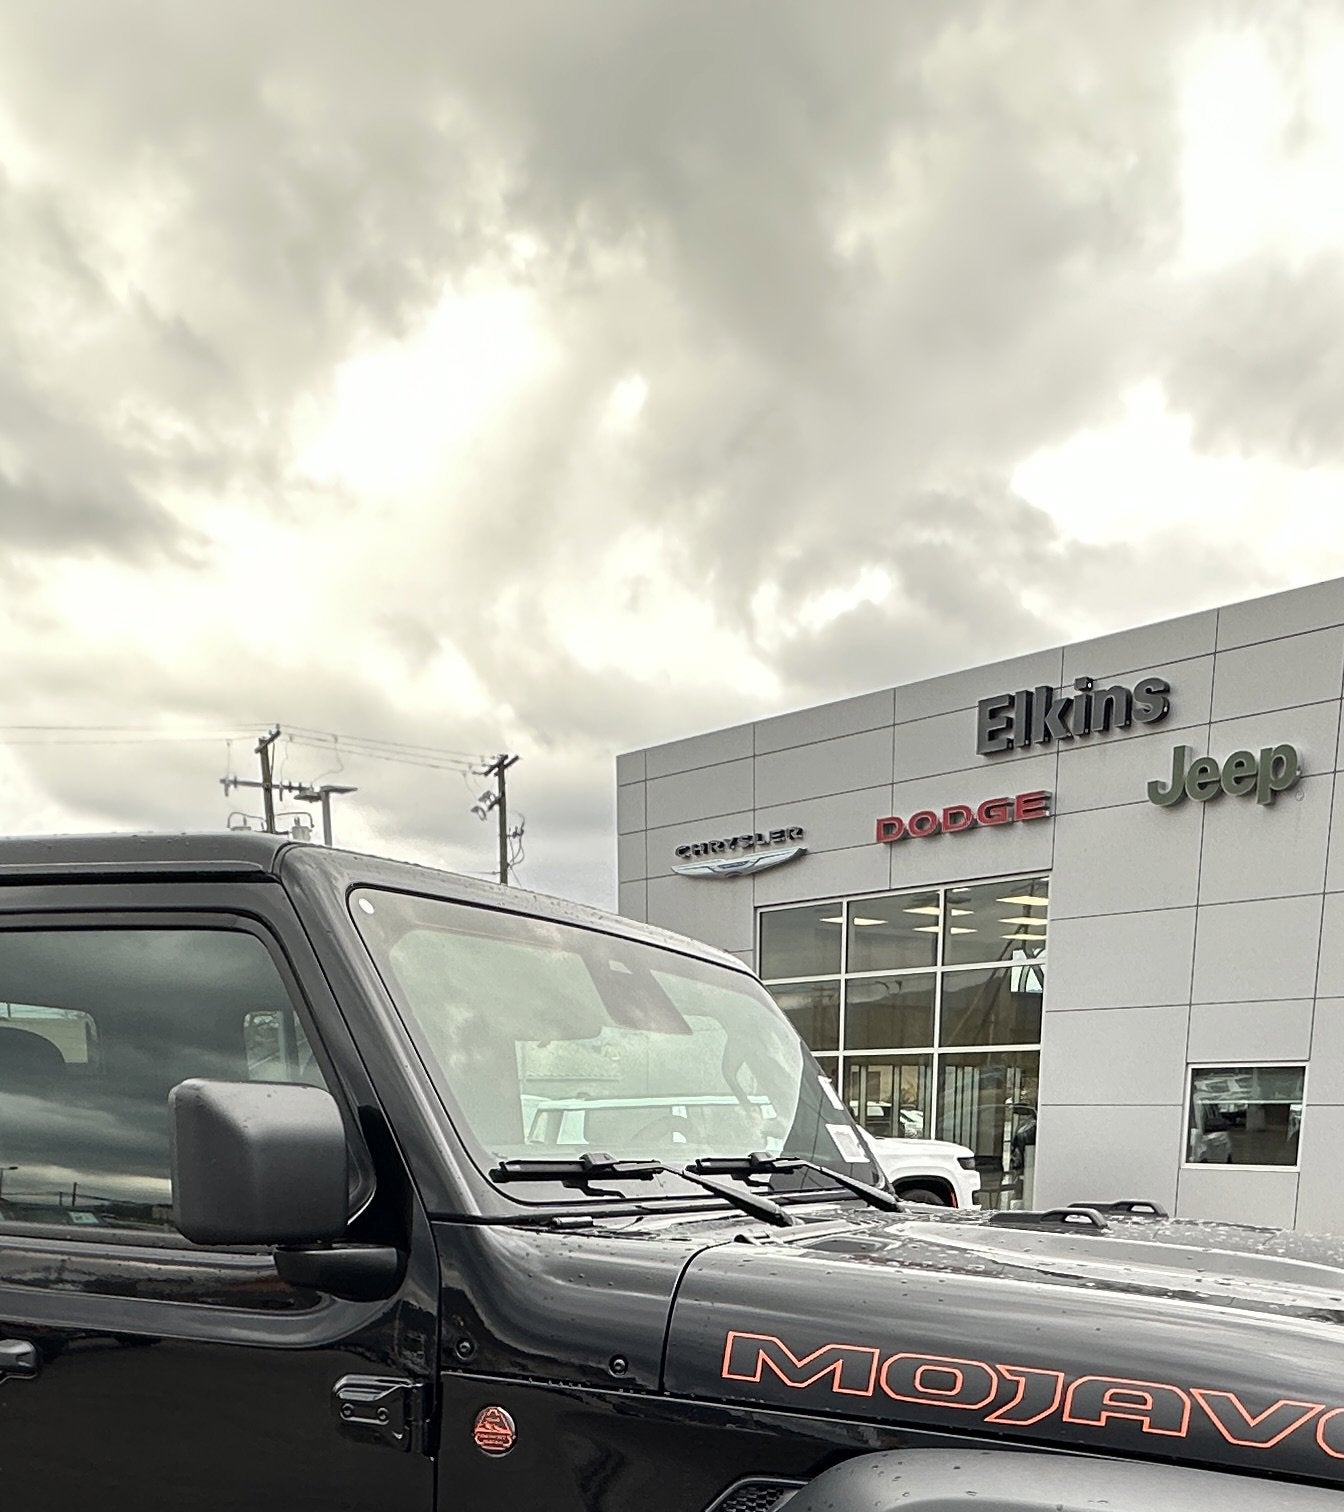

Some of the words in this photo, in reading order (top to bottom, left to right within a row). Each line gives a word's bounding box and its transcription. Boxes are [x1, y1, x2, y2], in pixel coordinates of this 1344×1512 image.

[976, 675, 1171, 755] Elkins
[1147, 742, 1301, 806] Jeep
[674, 826, 806, 859] CHRYSLER
[876, 790, 1052, 843] DODGE
